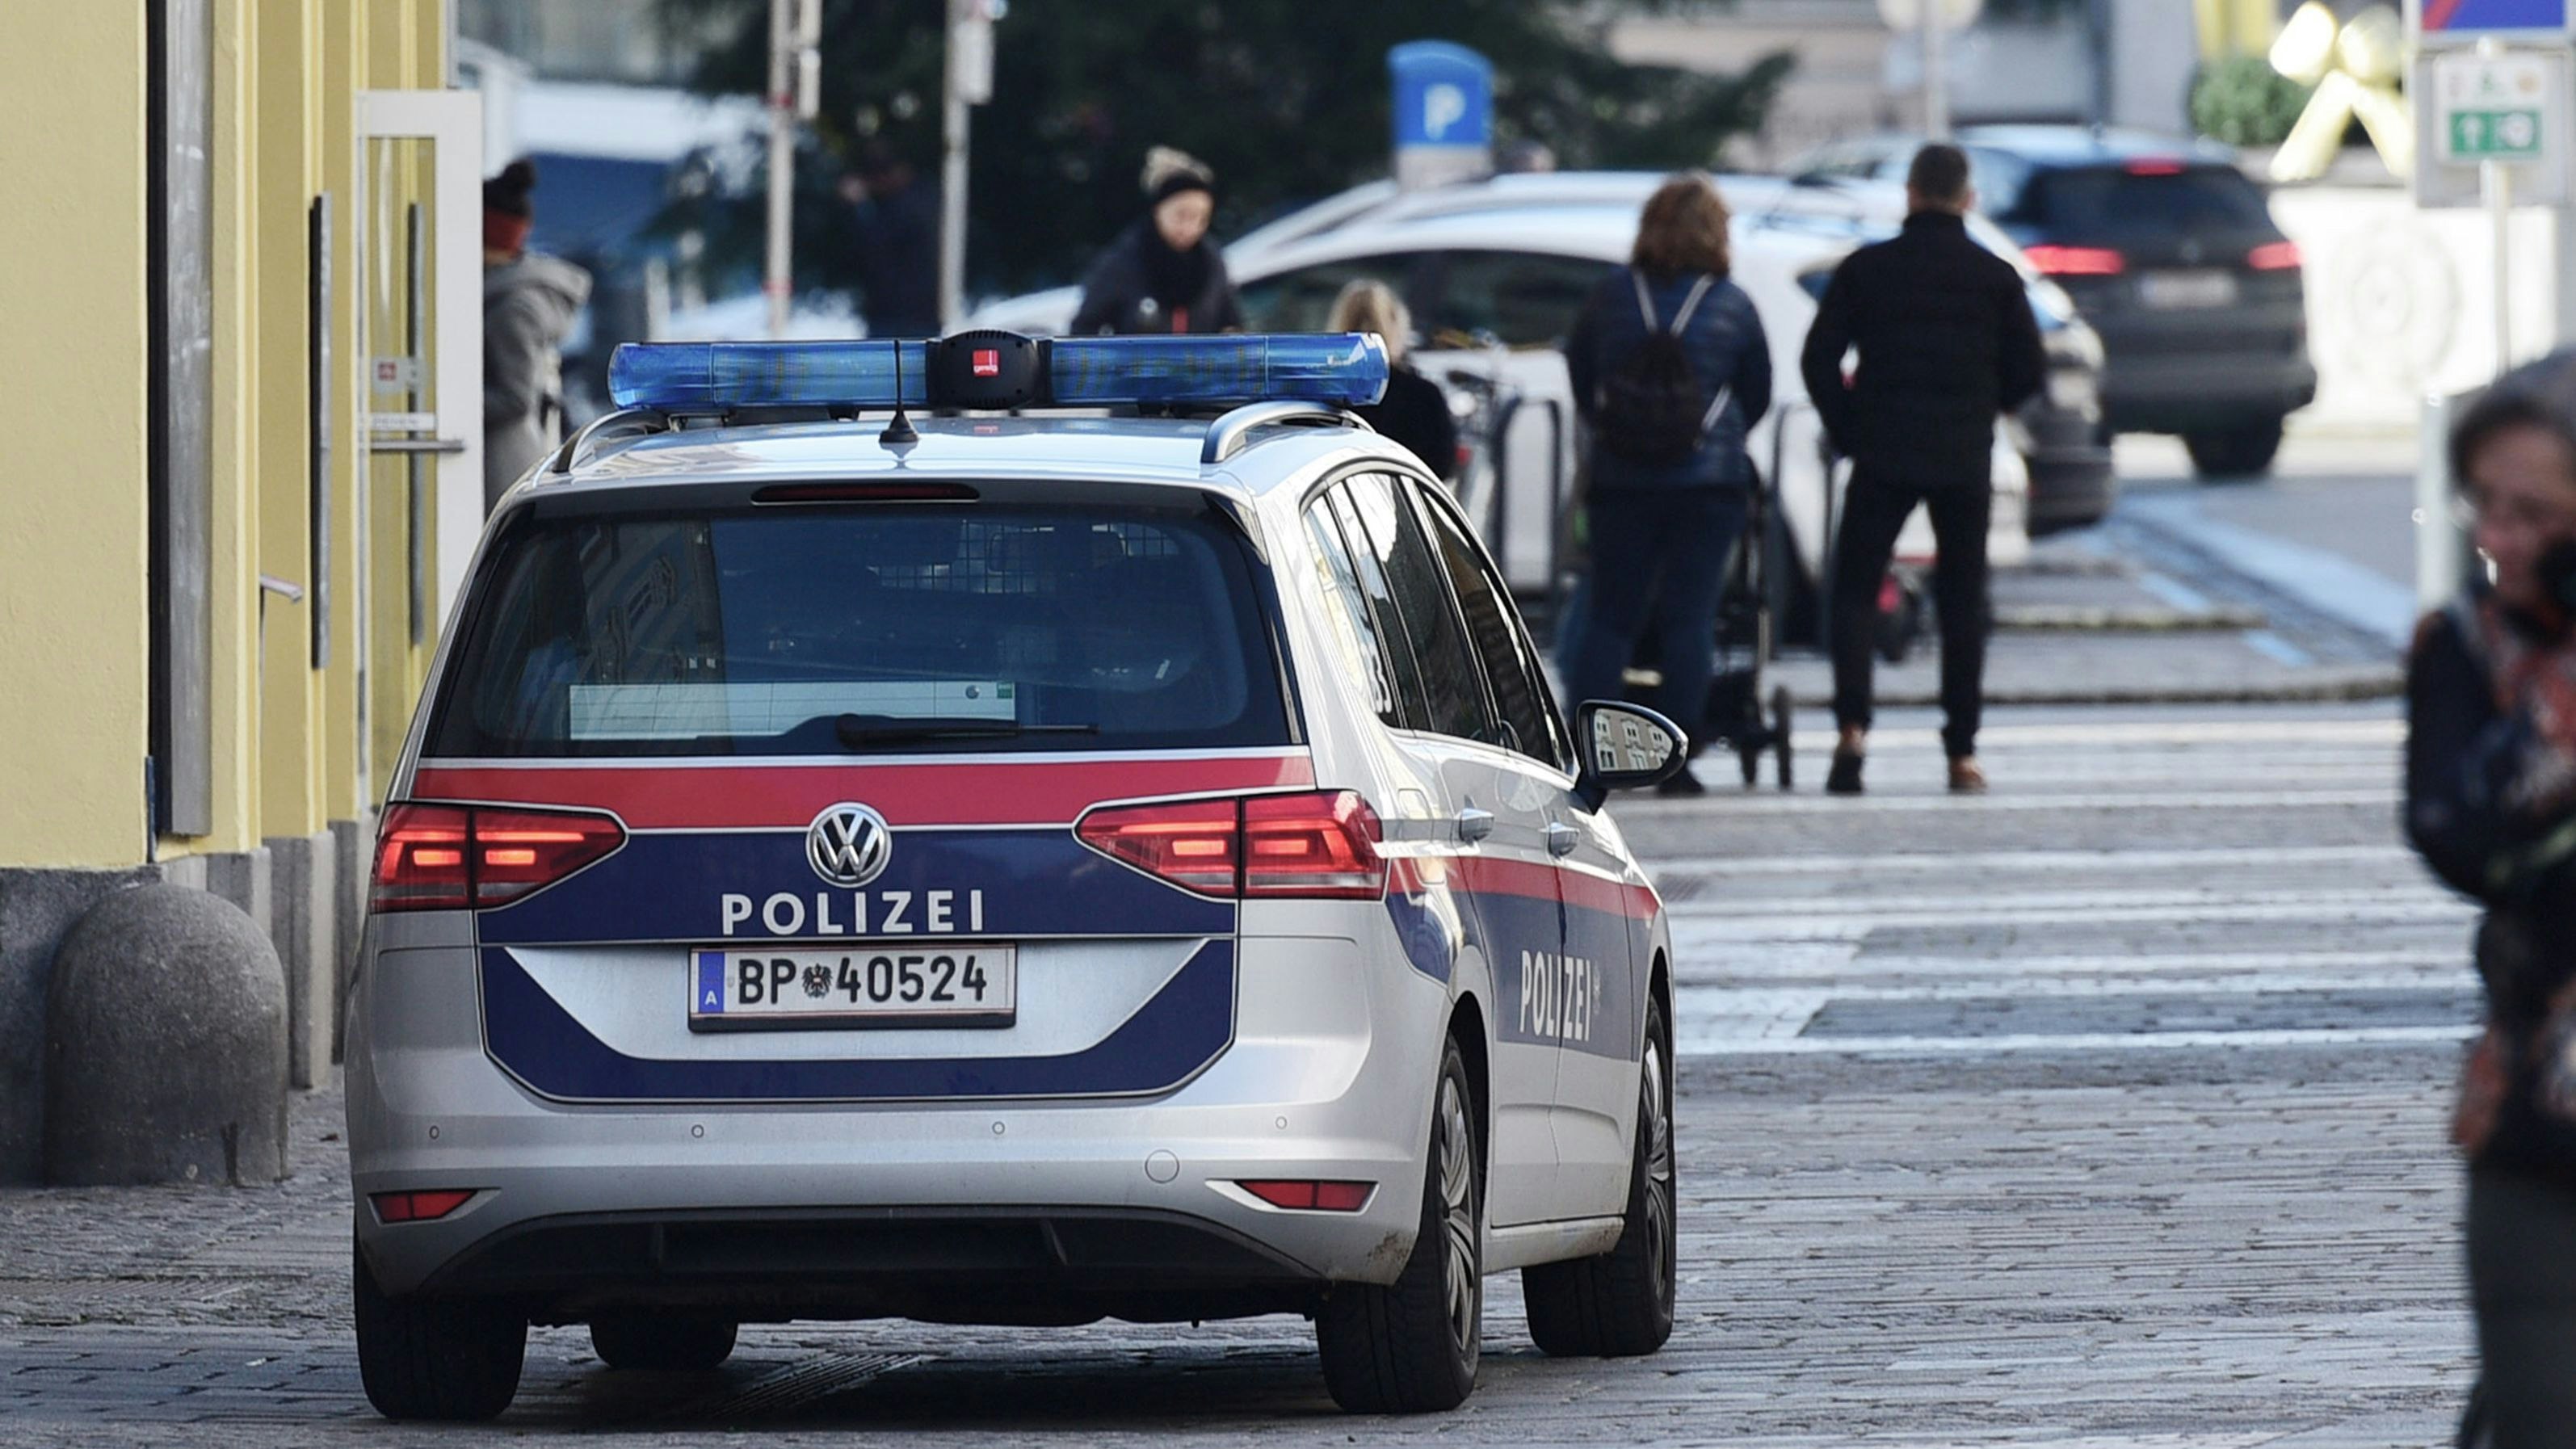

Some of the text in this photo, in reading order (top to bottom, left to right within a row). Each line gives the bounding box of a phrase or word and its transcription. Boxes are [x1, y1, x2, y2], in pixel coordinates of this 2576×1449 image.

[1424, 84, 1466, 141] P
[721, 889, 983, 935] POLIZEI
[704, 990, 718, 1006] A
[738, 955, 987, 1005] BP 40524
[1519, 950, 1591, 1042] POLIZEI
